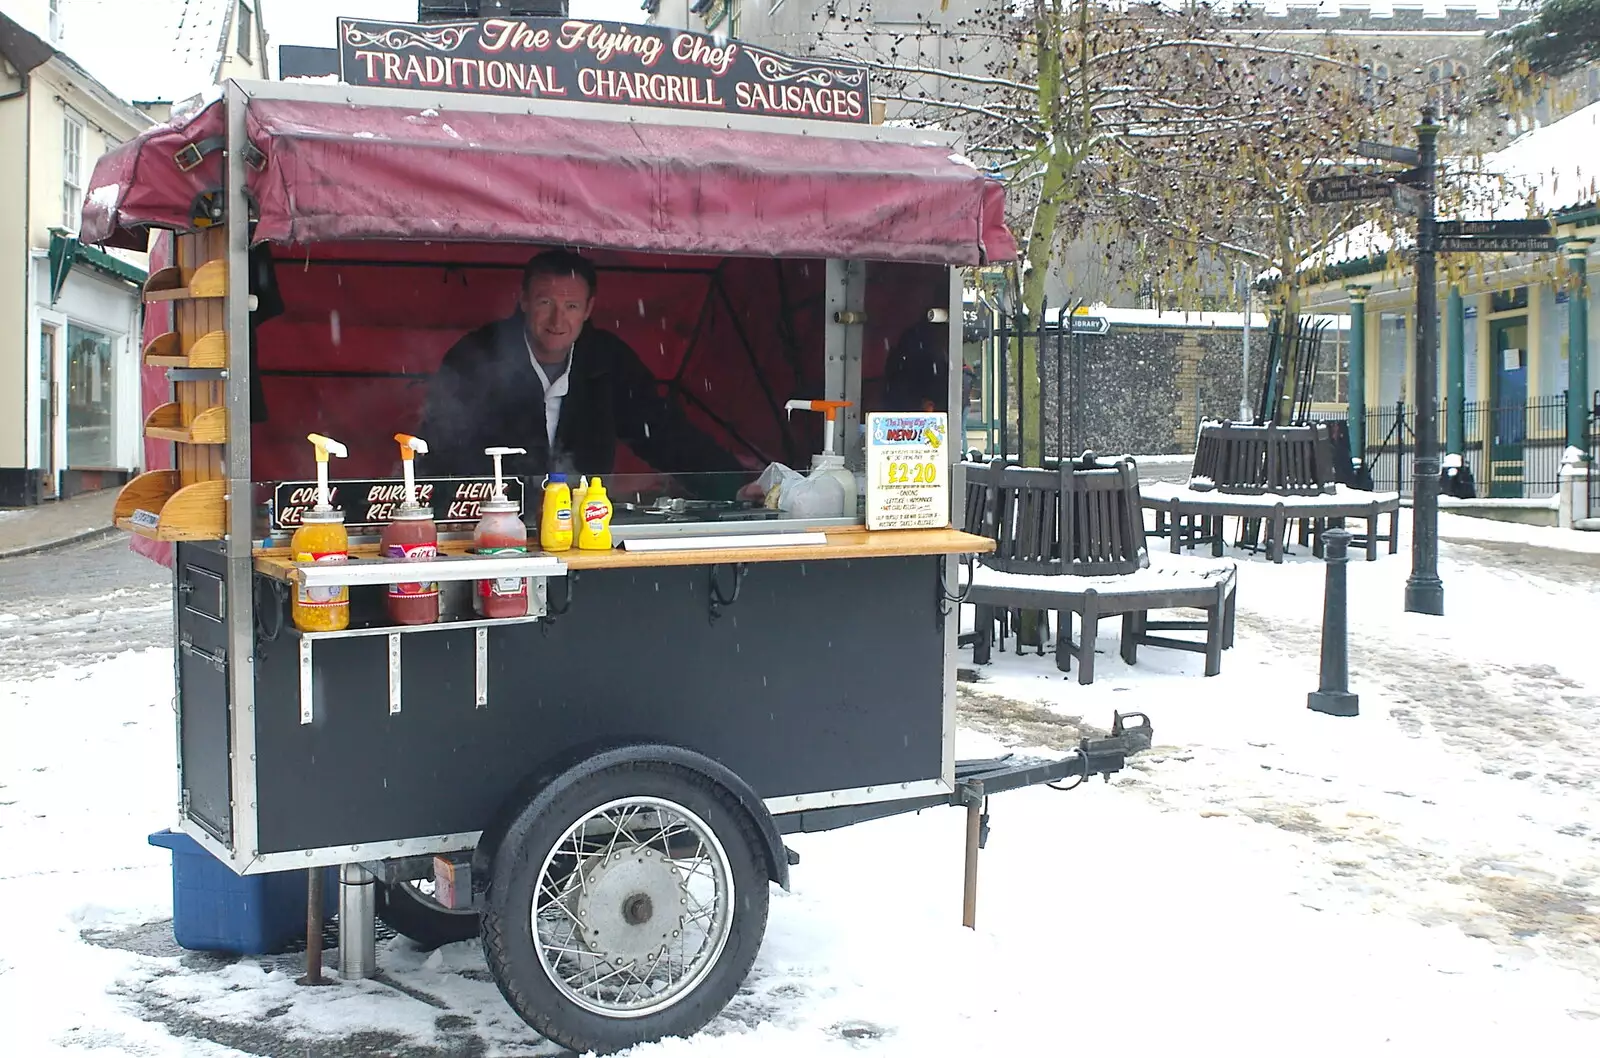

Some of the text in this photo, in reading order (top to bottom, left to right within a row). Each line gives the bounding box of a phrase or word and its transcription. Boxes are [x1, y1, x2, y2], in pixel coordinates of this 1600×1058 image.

[478, 19, 738, 75] The Flying Chef
[355, 50, 863, 118] TRADITIONAL CHARGRILL SAUSAGES
